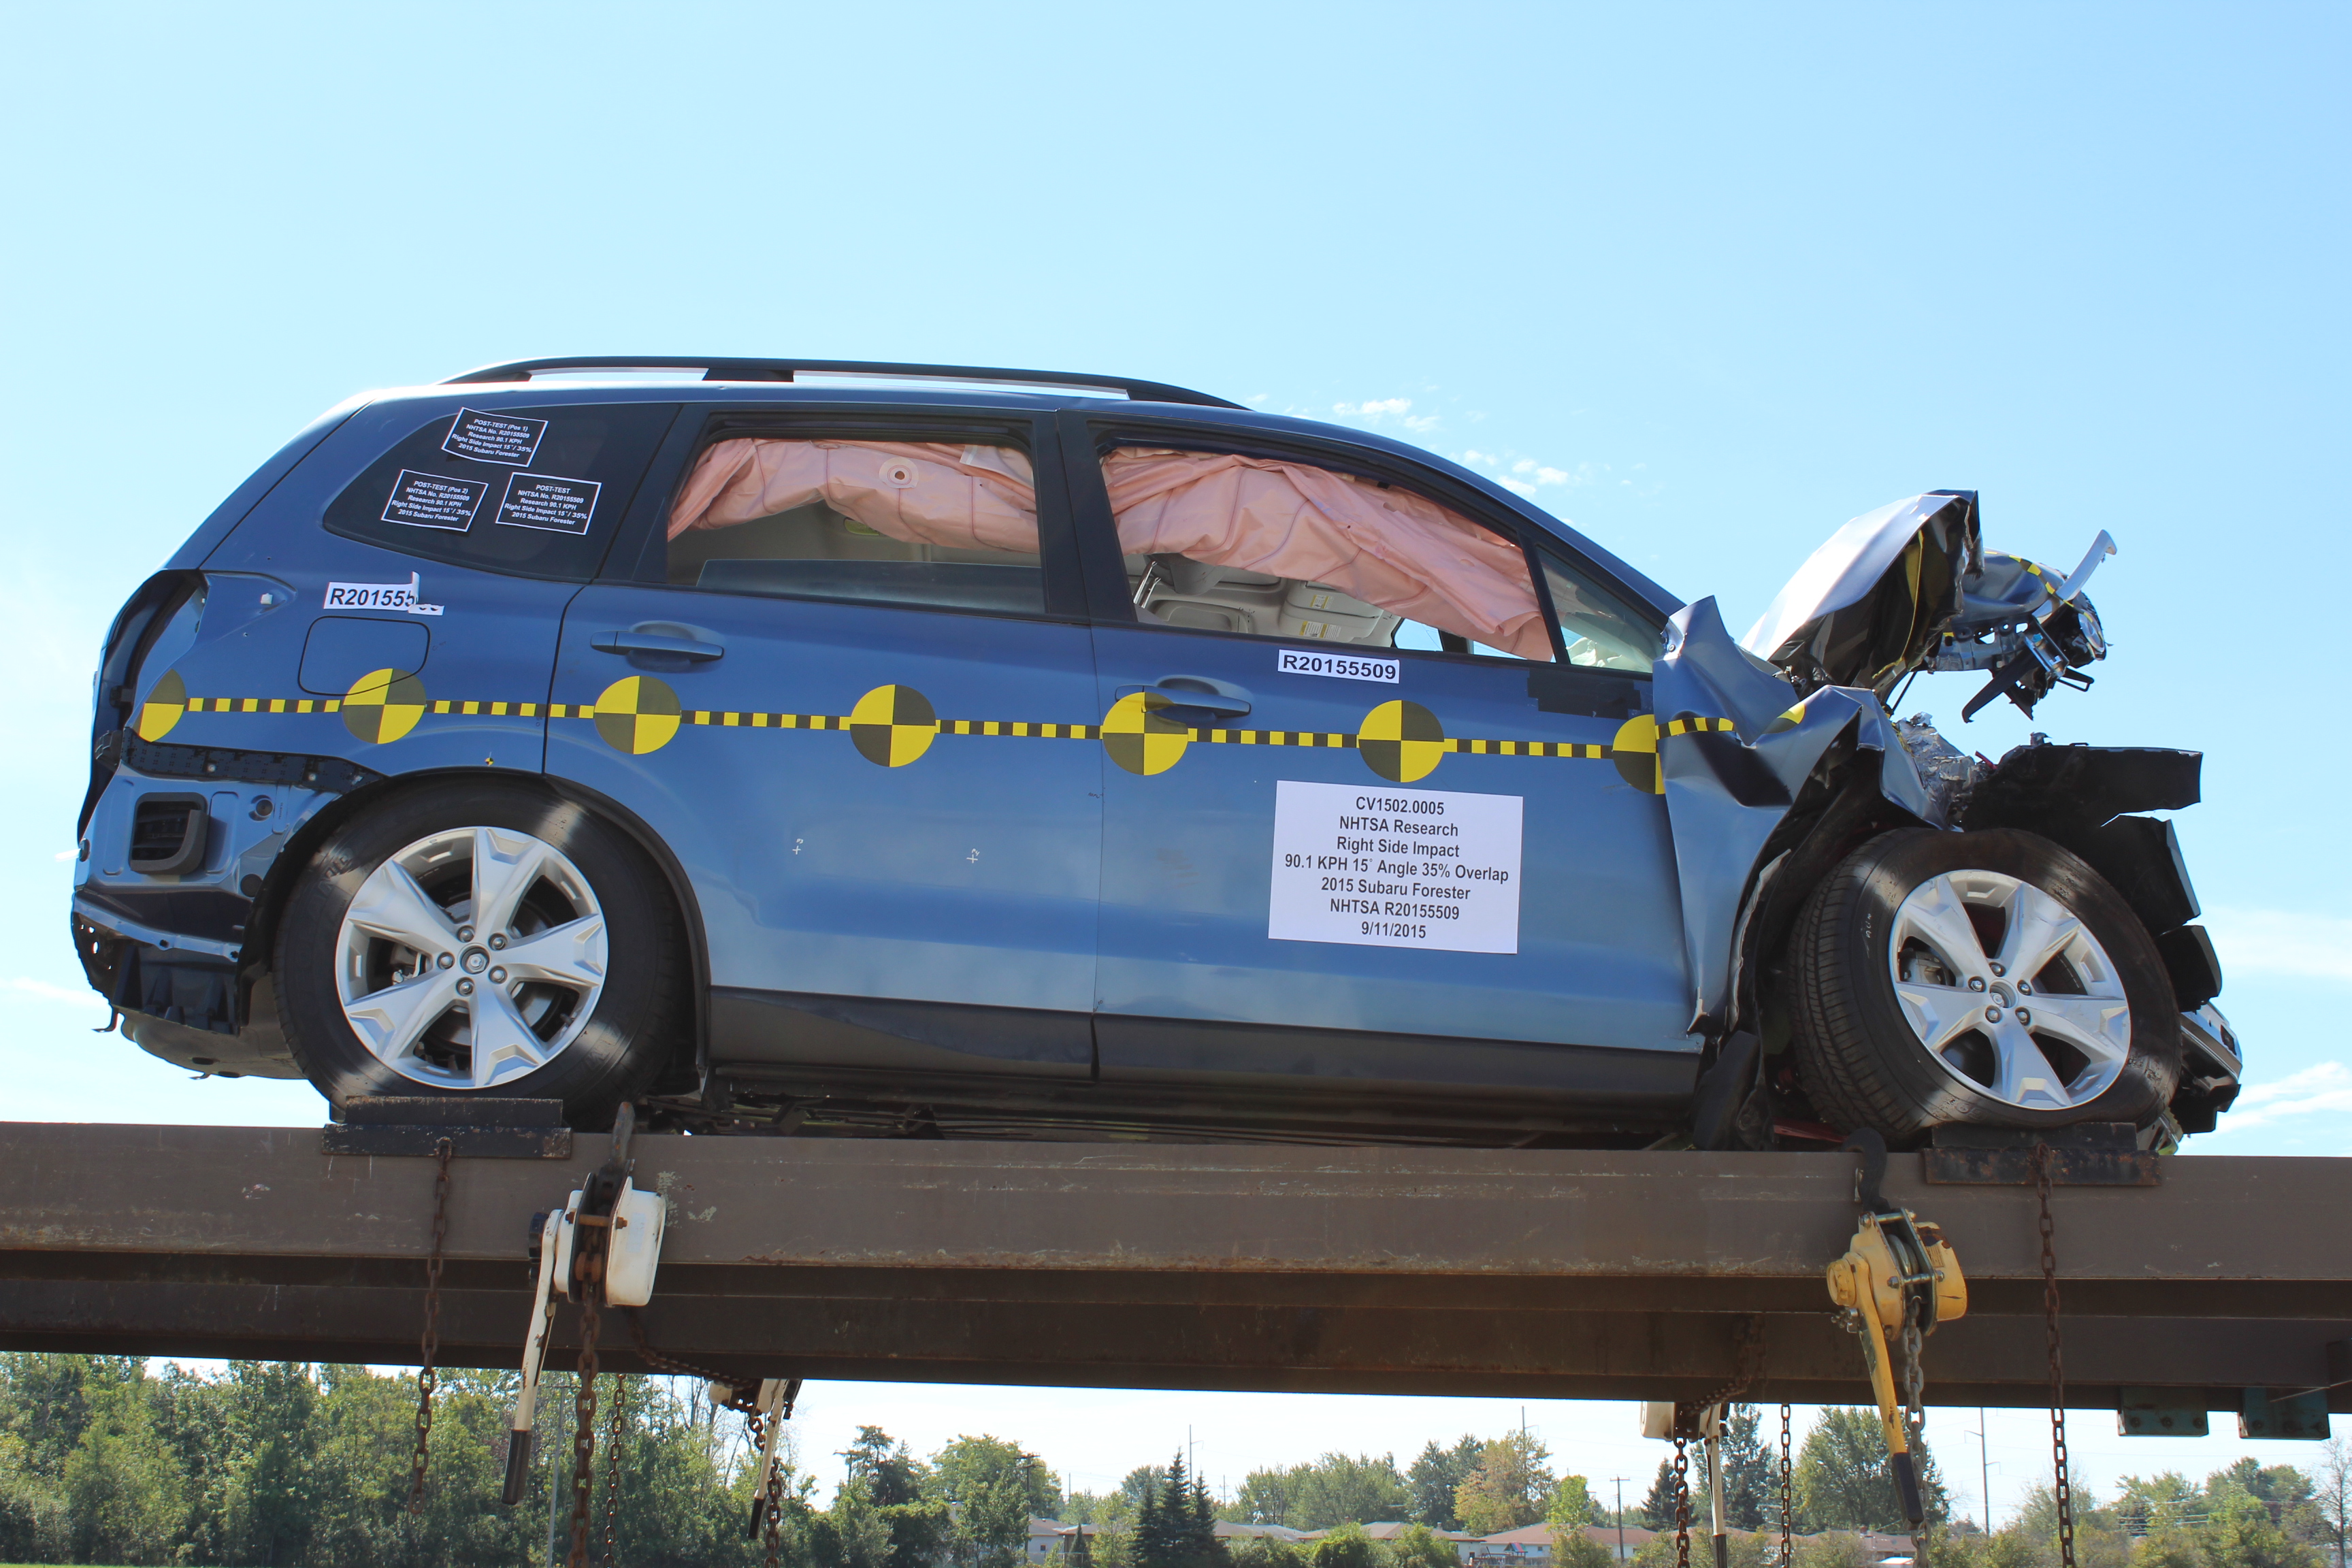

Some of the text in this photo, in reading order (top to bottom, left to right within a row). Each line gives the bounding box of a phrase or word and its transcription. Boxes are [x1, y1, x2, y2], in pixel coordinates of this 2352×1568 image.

[474, 419, 508, 429] POST-TEST
[466, 424, 487, 433] NHTSA
[499, 429, 529, 438] R20155509
[468, 431, 495, 441] Research
[452, 434, 468, 442] Right
[414, 480, 448, 491] POST-TEST
[536, 485, 571, 494] POST-TEST
[406, 487, 427, 495] NHTSA
[438, 493, 470, 501] R20155509
[408, 495, 435, 504] Research
[551, 494, 584, 504] R20155509
[391, 500, 408, 508] Right
[520, 497, 548, 506] Research
[536, 507, 557, 515] Impact
[550, 517, 575, 525] Forester
[1284, 655, 1396, 679] R20155509
[1356, 796, 1444, 815] CV1502.0005
[1339, 815, 1458, 836] NHTSA Research
[1337, 836, 1459, 859] Right Side Impact
[1285, 853, 1311, 868] 90.1
[1318, 855, 1348, 870] KPH
[1376, 859, 1417, 878] Angle
[1422, 862, 1450, 878] 35%
[1455, 864, 1508, 884] Overlap
[1321, 877, 1471, 899] 2015 Subaru Forester
[1330, 898, 1459, 919] NHTSA R20155509
[1361, 921, 1426, 938] 9/11/2015
